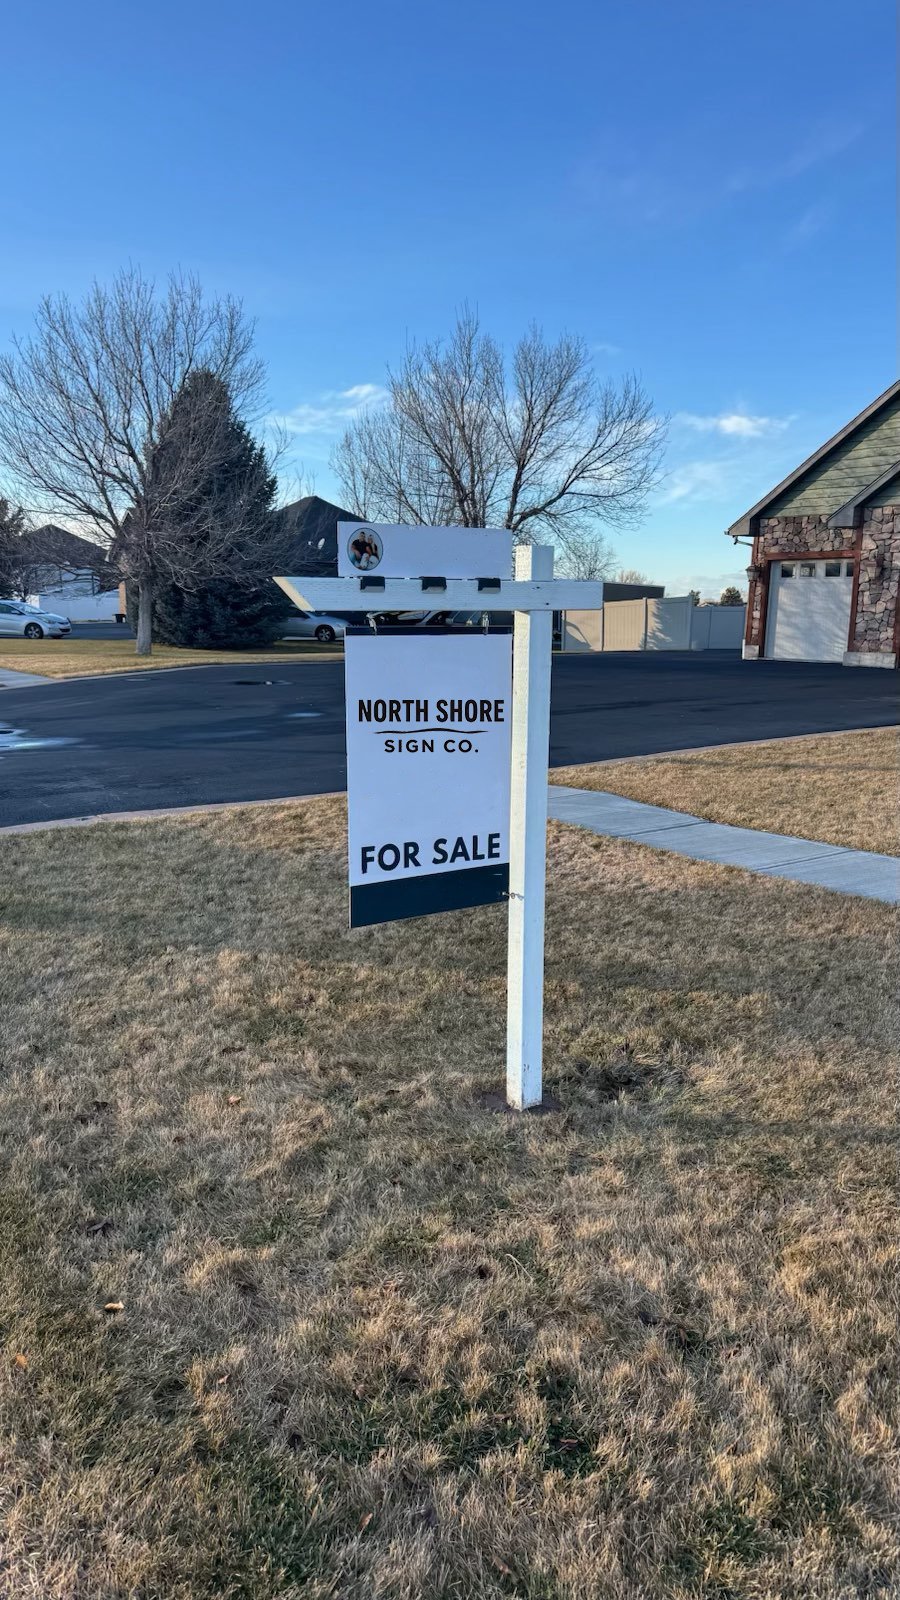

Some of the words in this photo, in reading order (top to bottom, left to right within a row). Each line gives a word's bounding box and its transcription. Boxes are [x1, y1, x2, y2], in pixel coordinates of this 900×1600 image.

[358, 699, 429, 723] NORTH
[435, 699, 505, 723] SHORE
[384, 739, 435, 753] SIGN
[443, 739, 479, 753] CO.
[361, 841, 422, 875] FOR
[432, 833, 501, 865] SALE
